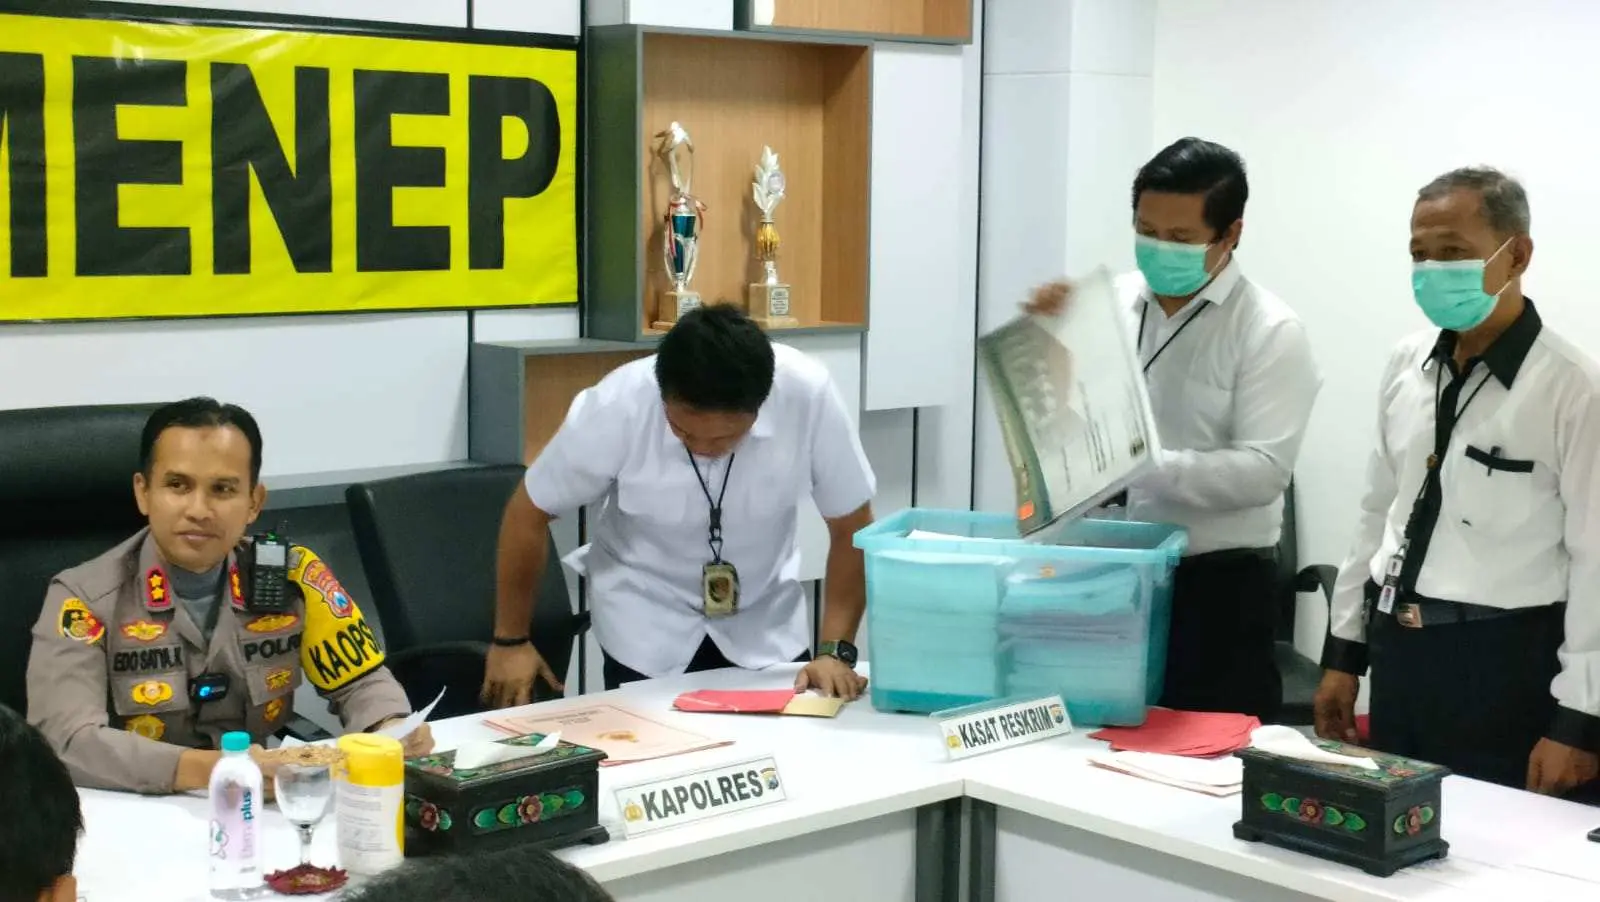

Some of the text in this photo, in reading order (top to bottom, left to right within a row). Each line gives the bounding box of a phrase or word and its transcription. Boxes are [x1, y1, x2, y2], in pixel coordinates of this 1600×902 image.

[113, 651, 139, 672] EDO
[958, 705, 1054, 748] KASAT RESKRIM
[641, 769, 763, 821] KAPOLRES
